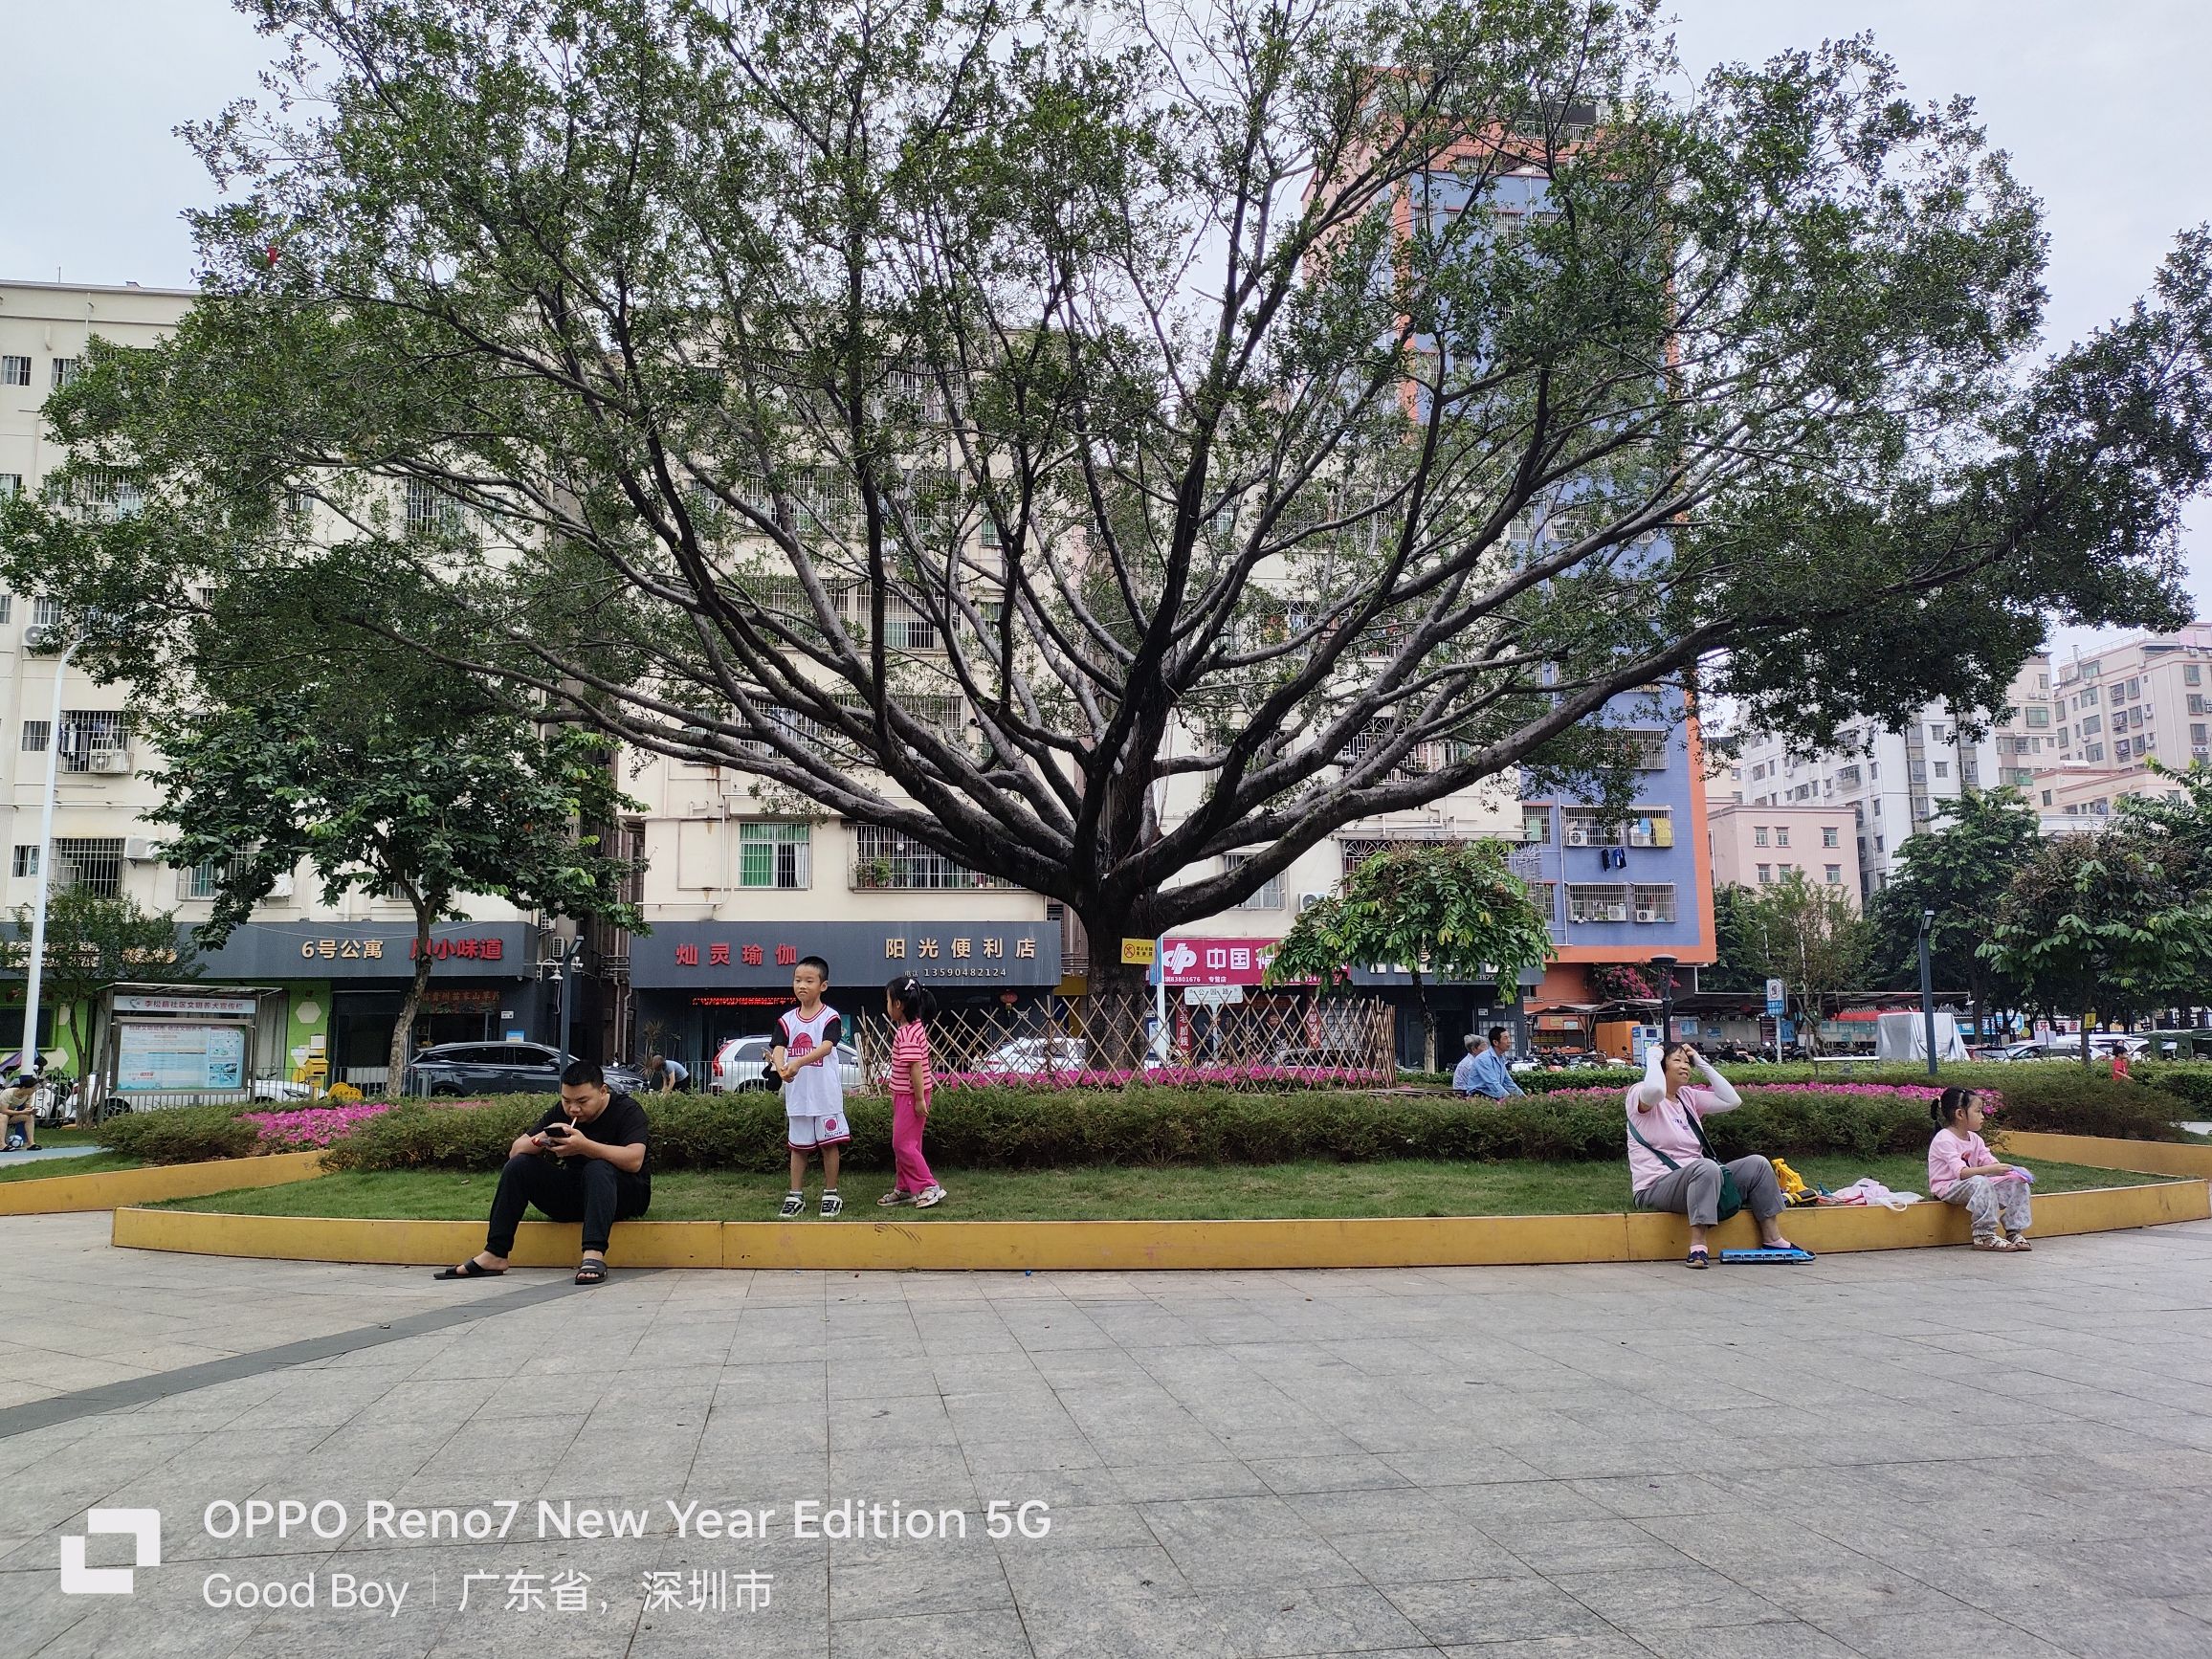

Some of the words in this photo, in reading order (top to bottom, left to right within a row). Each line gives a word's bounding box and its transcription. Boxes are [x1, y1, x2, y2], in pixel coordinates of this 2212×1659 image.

[301, 939, 384, 959] 6号公寓
[675, 942, 797, 965] 灿灵瑜伽
[885, 937, 1036, 959] 阳光便利店
[924, 968, 1006, 978] 13590482124
[1198, 987, 1229, 997] 公园路
